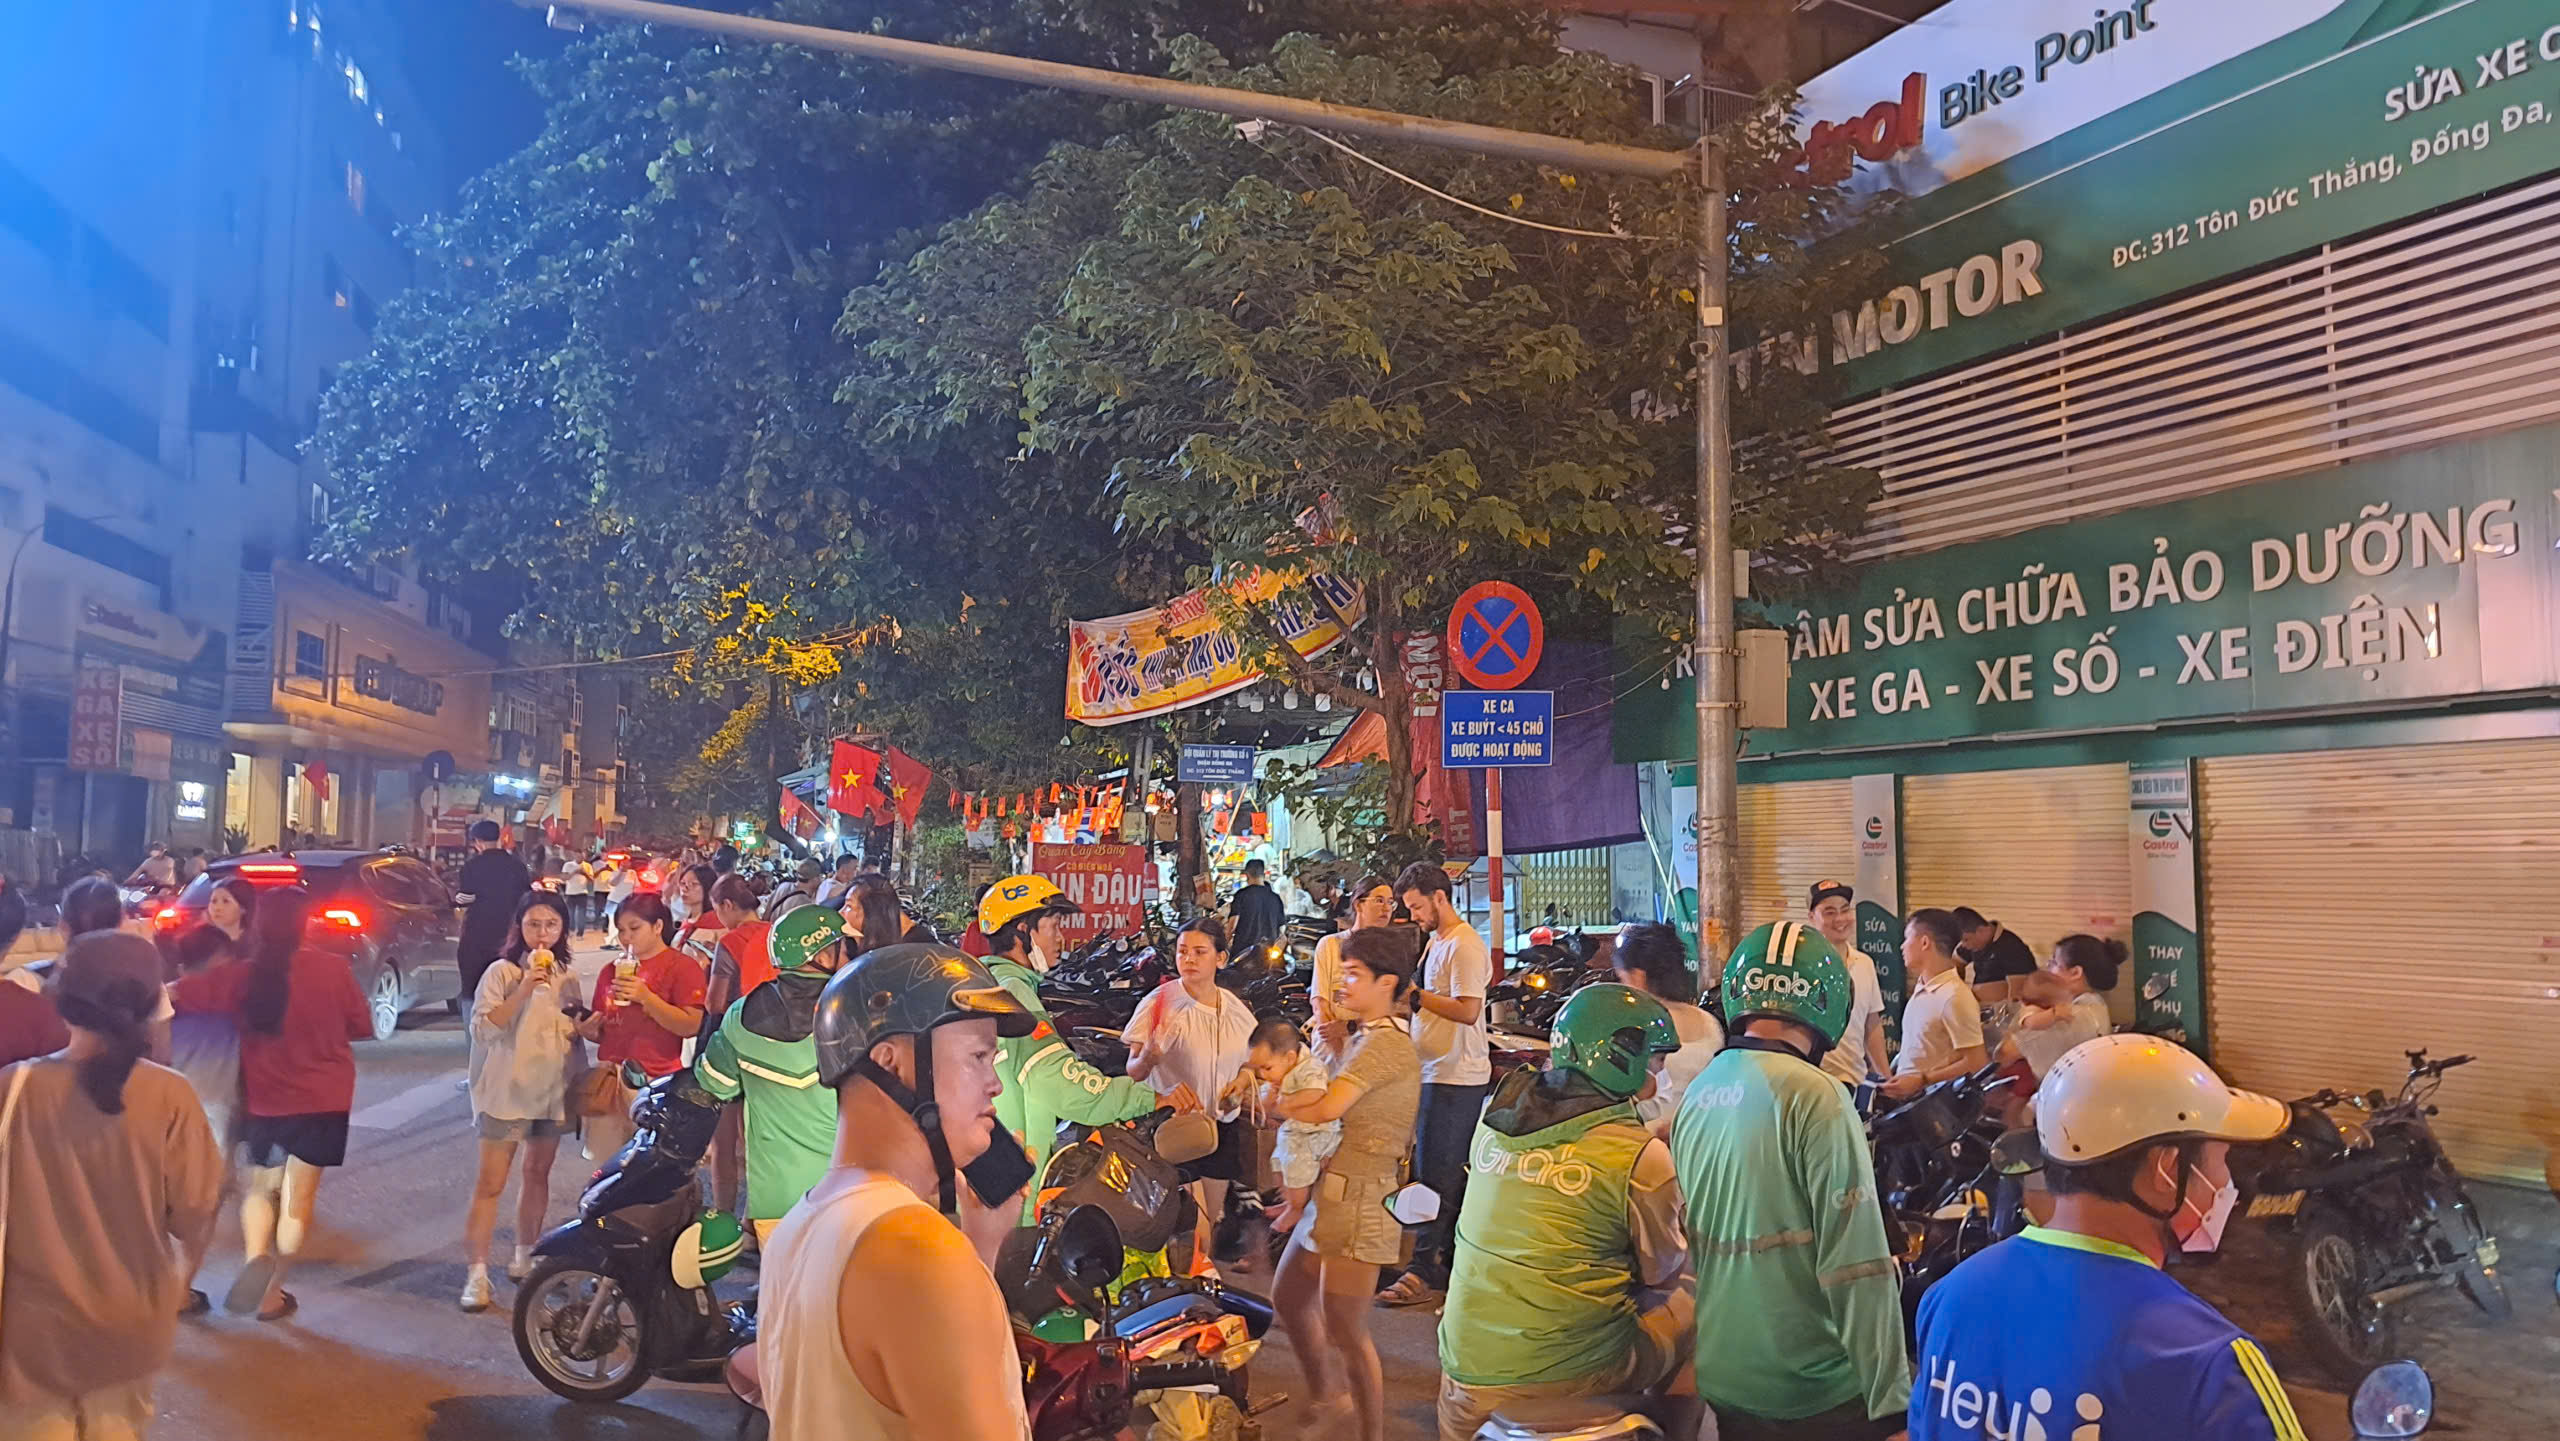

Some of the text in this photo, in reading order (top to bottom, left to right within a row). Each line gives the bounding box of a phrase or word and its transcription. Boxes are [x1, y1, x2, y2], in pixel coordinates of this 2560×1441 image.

[1939, 65, 2023, 130] Bike
[2033, 0, 2159, 82] Point
[2384, 65, 2463, 122] SỬA
[2476, 38, 2528, 88] XE
[2112, 101, 2553, 268] ĐC: 312 Tôn Đức Thắng, Đống Đa,
[1832, 240, 2044, 366] MOTOR
[1788, 609, 1850, 661] ÂM
[1864, 587, 1945, 651] SỬA
[1957, 562, 2088, 635] CHỮA
[2109, 537, 2225, 613] BẢO
[2251, 498, 2519, 594] DƯỠNG
[1809, 675, 1858, 722] XE
[1871, 668, 1932, 715] GA
[1976, 654, 2035, 706] XE
[2052, 624, 2120, 697] SỐ
[2176, 626, 2251, 686] XE
[2273, 593, 2443, 681] ĐIỆN
[1482, 699, 1515, 714] XE CA
[1451, 721, 1466, 736] XE
[1468, 717, 1496, 736] BUÝT
[1506, 721, 1521, 736] 45
[1522, 714, 1544, 735] CHỖ
[1451, 739, 1542, 761] ĐƯỢC HOẠT ĐỘNG
[2143, 840, 2180, 850] Castrol
[1001, 884, 1030, 901] be
[1040, 862, 1142, 911] ÚN ĐẬU
[799, 923, 832, 948] Grab
[1861, 940, 1893, 954] CHỮA
[2148, 945, 2184, 960] THAY
[1876, 960, 1889, 976] ẢO
[1745, 967, 1811, 997] Grab
[2153, 1000, 2182, 1018] PHỤ
[1697, 1081, 1744, 1109] Grab
[1475, 1132, 1593, 1197] Grab
